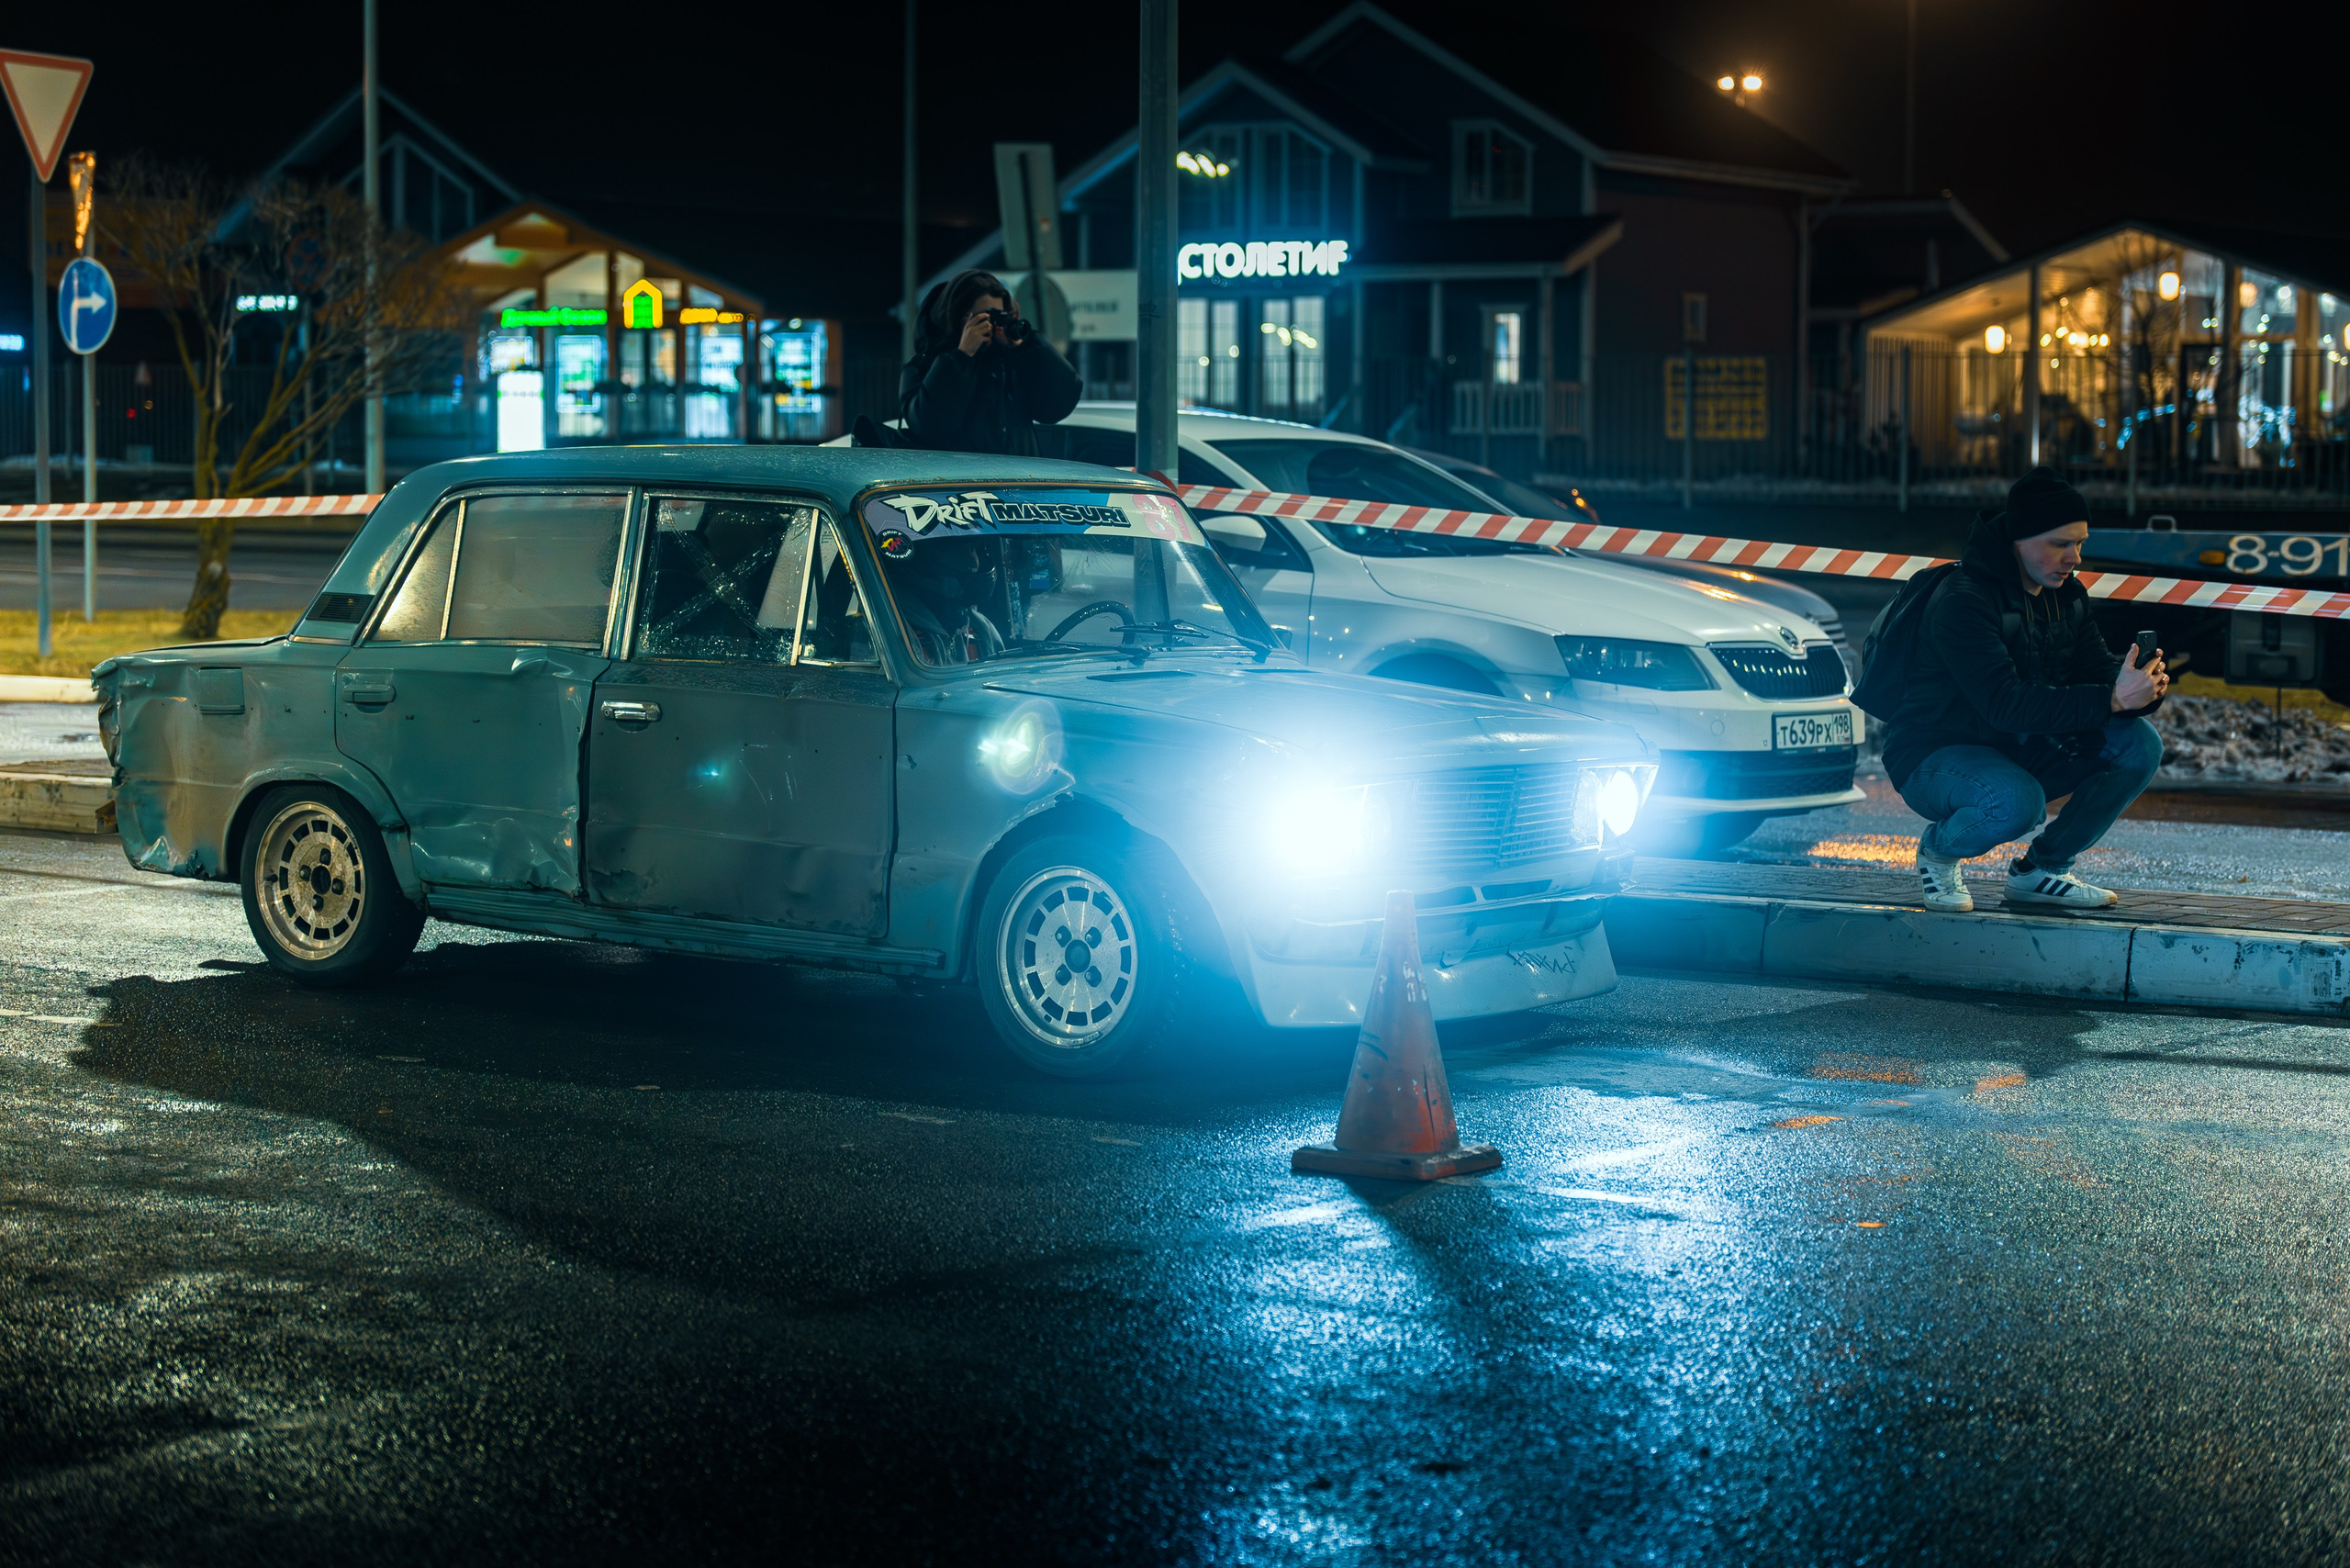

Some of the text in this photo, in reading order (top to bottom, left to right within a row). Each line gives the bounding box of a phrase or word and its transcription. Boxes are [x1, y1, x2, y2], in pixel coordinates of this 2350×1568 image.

[990, 502, 1132, 528] MATSURI
[885, 549, 912, 558] MATSURI
[1834, 714, 1850, 735] 198
